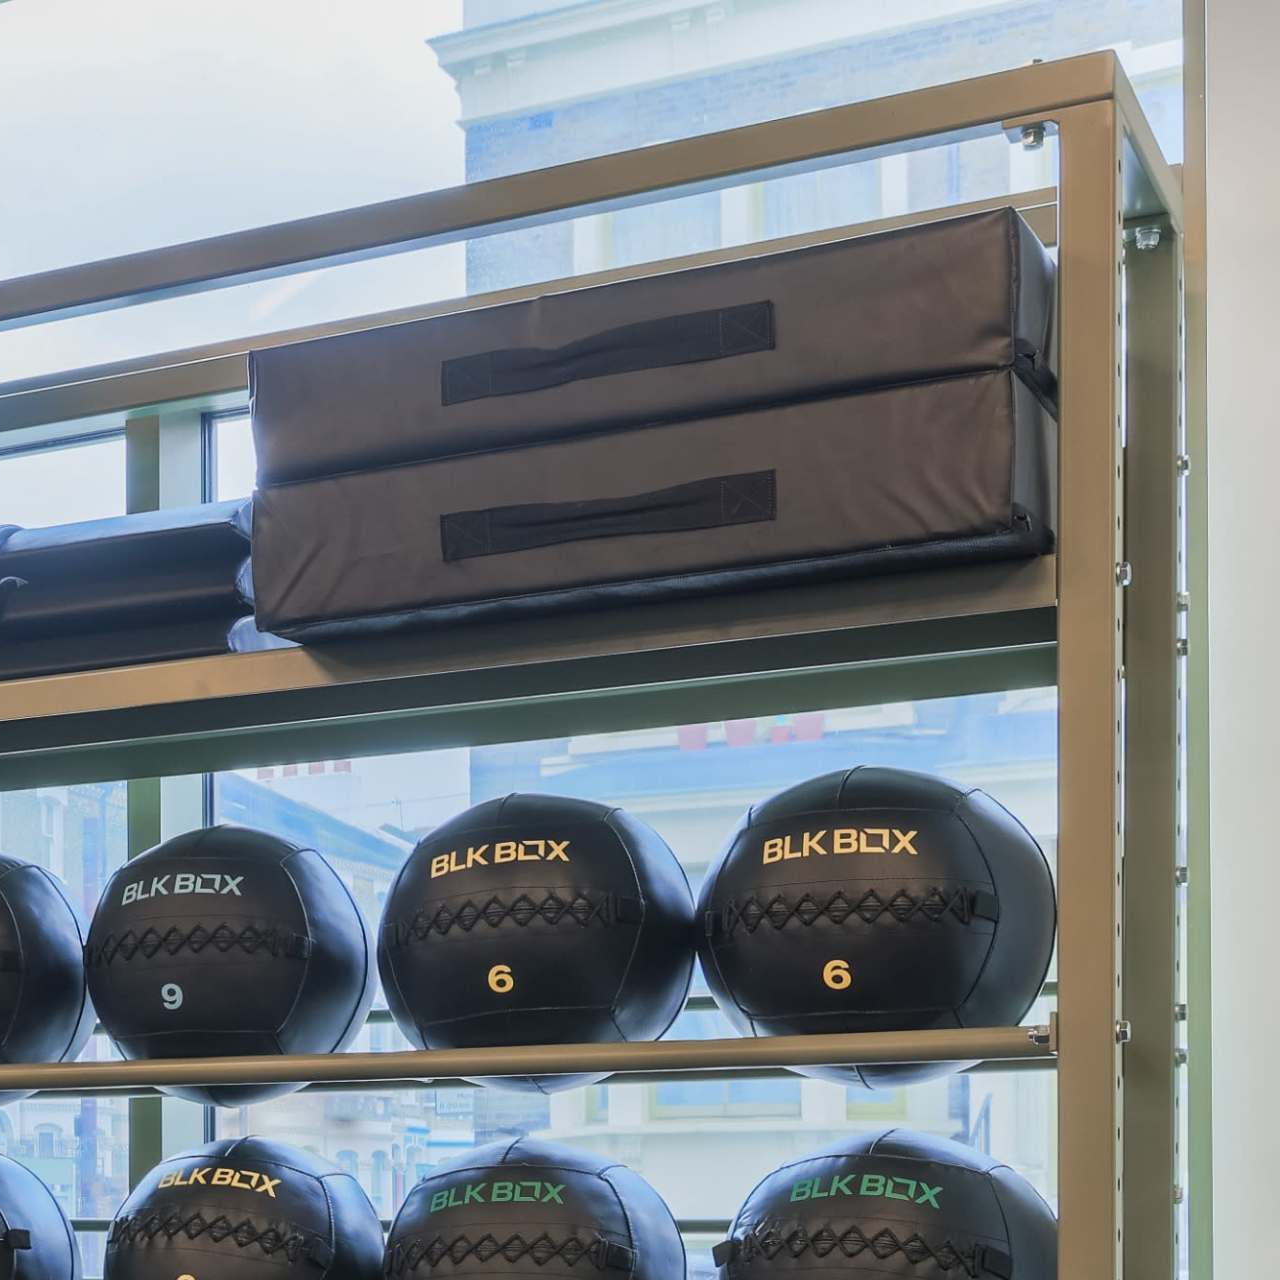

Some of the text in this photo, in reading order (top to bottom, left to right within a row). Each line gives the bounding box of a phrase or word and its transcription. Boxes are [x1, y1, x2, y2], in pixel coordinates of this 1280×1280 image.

[431, 841, 569, 878] BLK BOX
[763, 829, 917, 864] BLK BOX
[122, 874, 243, 905] BLK BOX
[488, 965, 513, 992] 6
[823, 960, 851, 989] 6
[162, 984, 183, 1009] 9
[159, 1169, 281, 1197] BLK BOX
[430, 1182, 565, 1212] BLK BOX
[791, 1175, 942, 1208] BLK BOX
